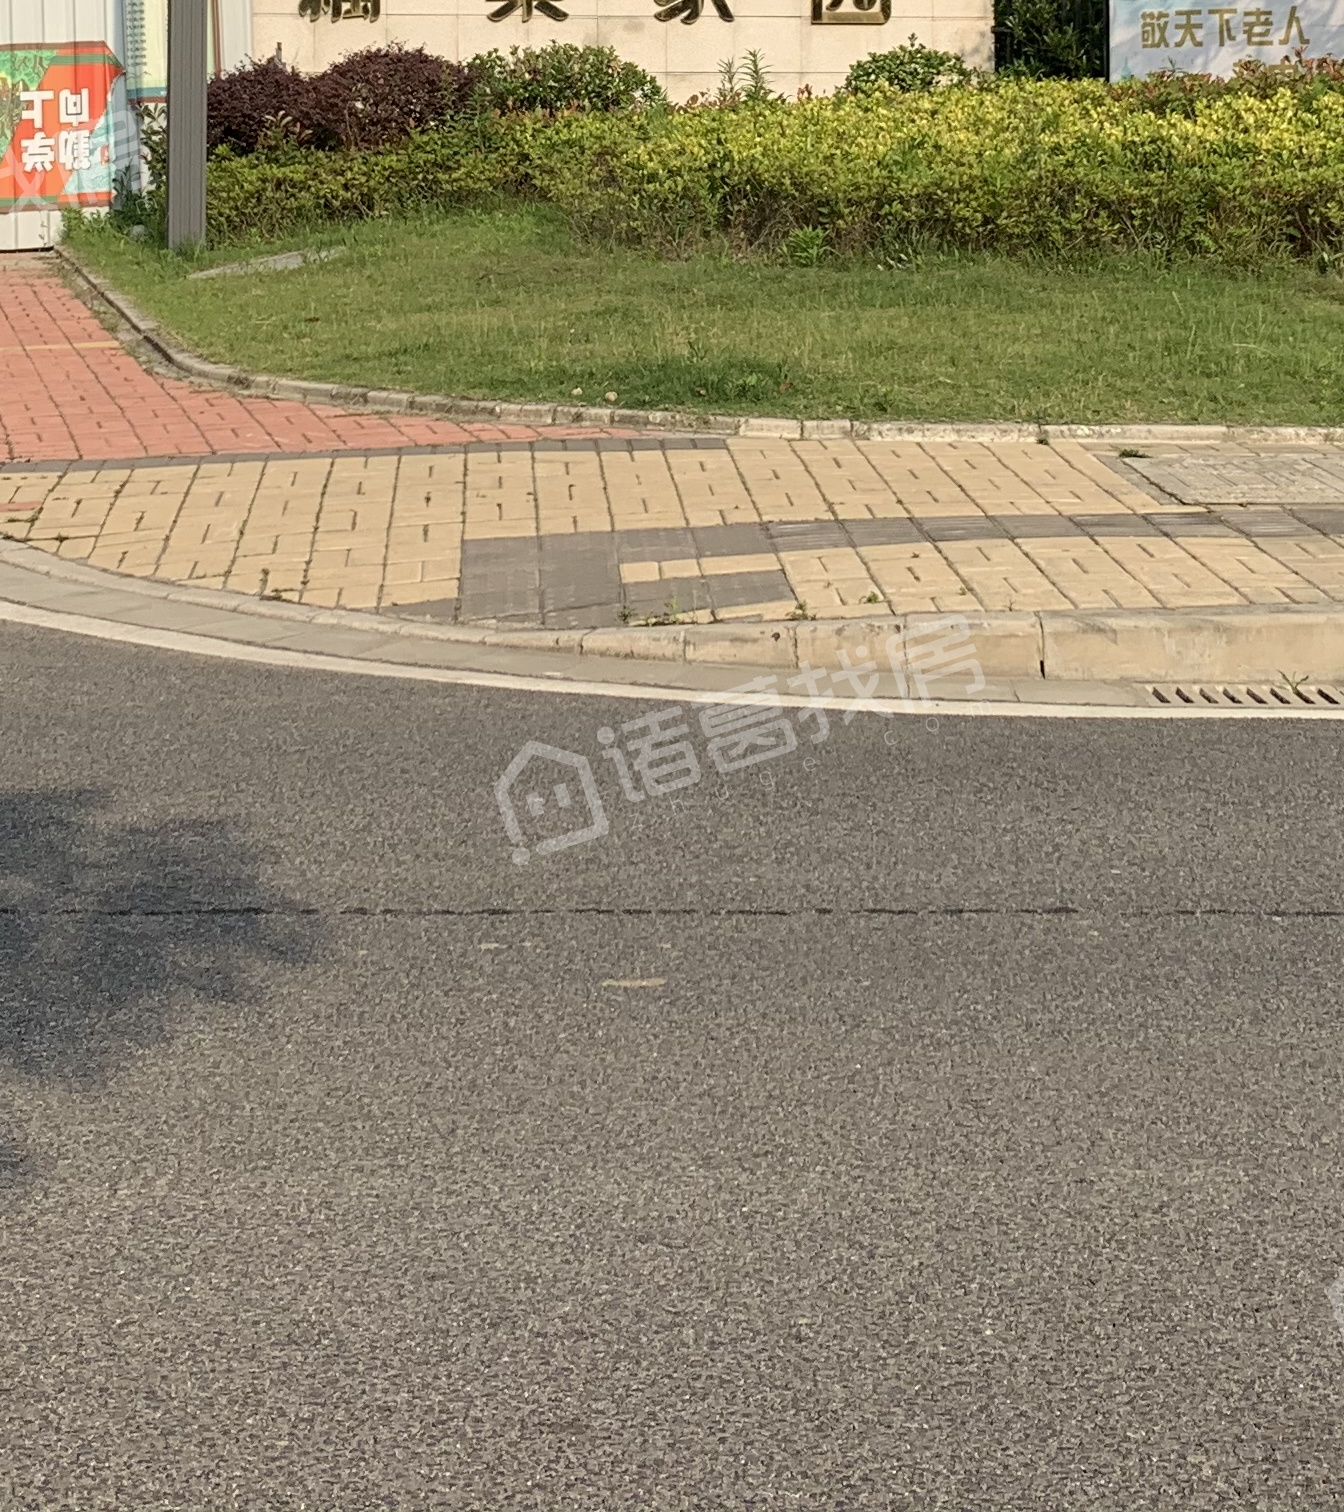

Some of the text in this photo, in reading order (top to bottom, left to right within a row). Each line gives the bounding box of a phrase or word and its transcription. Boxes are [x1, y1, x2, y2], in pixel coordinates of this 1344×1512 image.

[1140, 5, 1311, 49] 敬天下老人
[19, 87, 90, 129] 向上
